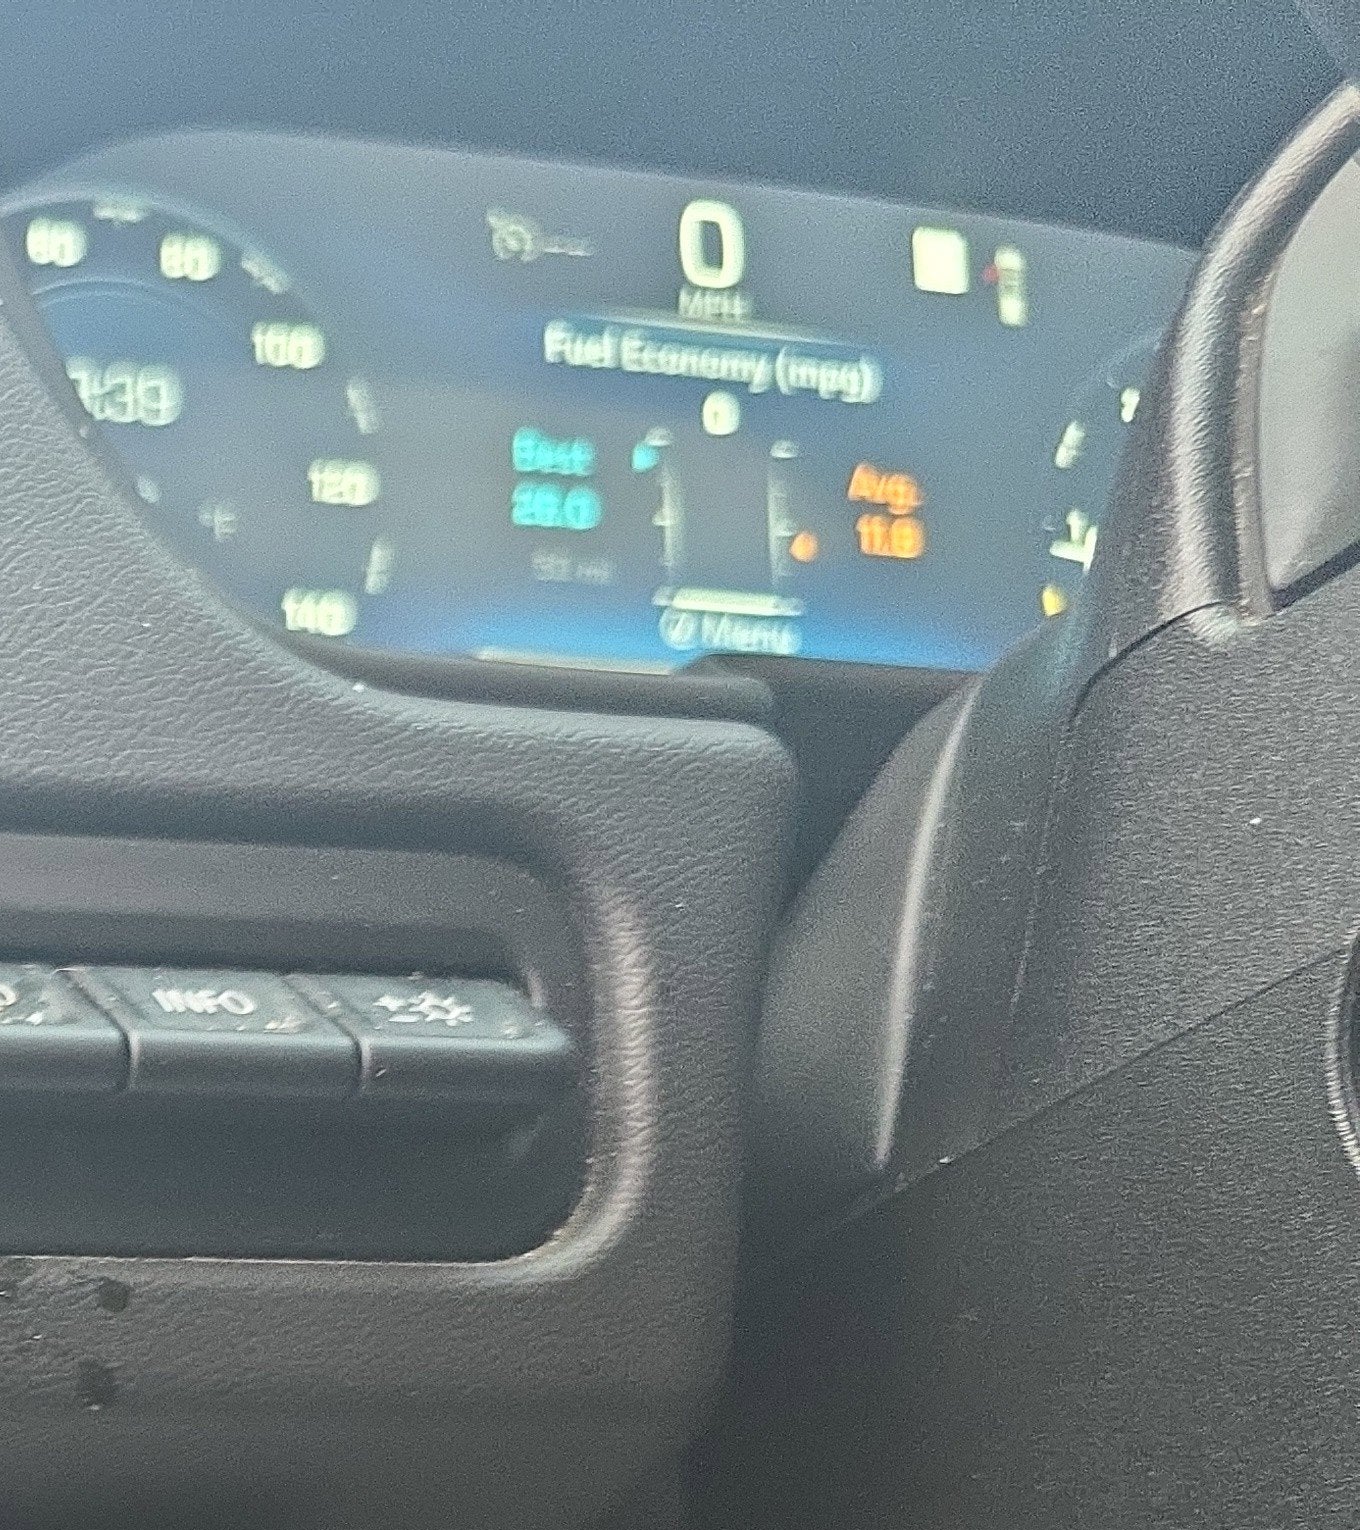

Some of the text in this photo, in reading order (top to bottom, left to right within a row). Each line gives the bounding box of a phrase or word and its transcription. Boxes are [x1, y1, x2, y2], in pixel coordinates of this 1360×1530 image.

[680, 199, 746, 289] 0
[251, 320, 325, 369] 100
[544, 319, 882, 403] Fuel Economy (mpg)
[307, 458, 379, 507] 120
[281, 586, 357, 636] 140
[701, 611, 803, 656] Menu
[153, 987, 258, 1016] INFO
